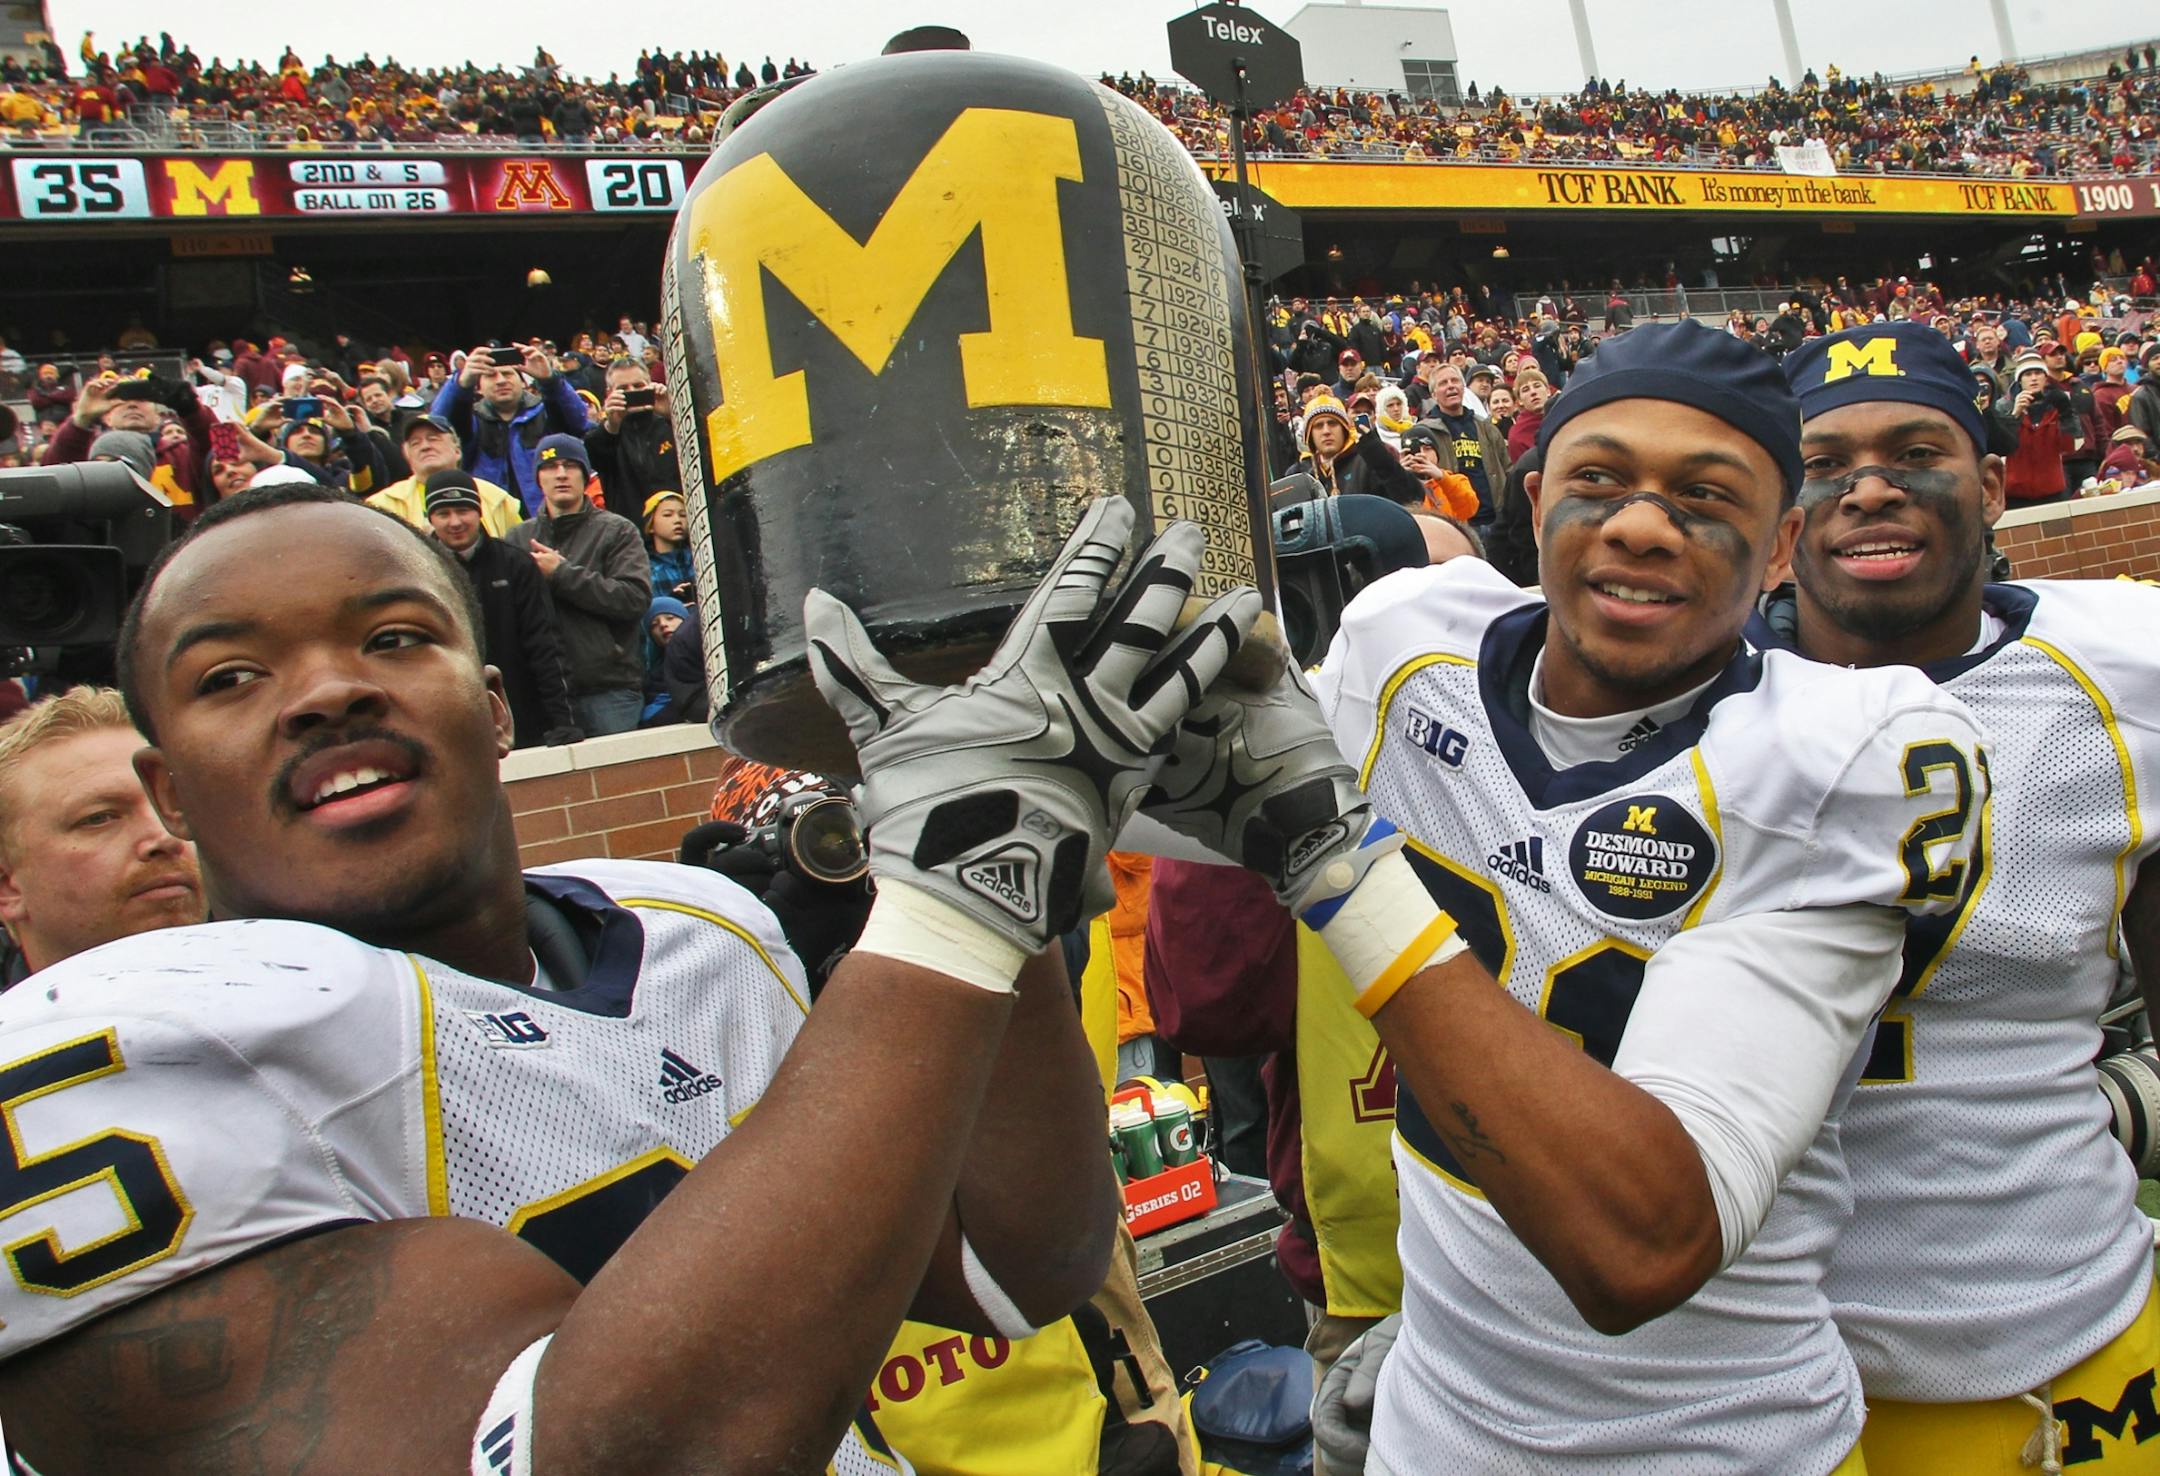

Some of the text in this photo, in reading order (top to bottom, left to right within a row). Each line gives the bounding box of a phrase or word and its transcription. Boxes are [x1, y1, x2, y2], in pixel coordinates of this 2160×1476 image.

[1202, 15, 1263, 45] Telex
[1116, 131, 1141, 151] 38
[33, 165, 124, 213] 35
[164, 160, 260, 215] M
[304, 165, 420, 183] 2ND & 5
[604, 164, 672, 206] 20
[1121, 151, 1145, 171] 16
[1153, 164, 1194, 194] 1922
[1538, 173, 1683, 205] TCF BANK
[303, 194, 360, 210] BALL
[405, 193, 436, 210] 26
[1124, 171, 1147, 195] 10
[1158, 181, 1195, 213] 1923
[1699, 177, 1876, 208] It's money in the bank.
[1959, 184, 1997, 209] TCF
[2080, 185, 2133, 212] 1900
[1126, 192, 1217, 244] 13 1924 0
[1126, 215, 1150, 236] 35
[1131, 239, 1153, 257] 20
[1164, 255, 1202, 283] 1926
[1138, 256, 1150, 270] 7
[689, 107, 1112, 486] M
[1138, 274, 1226, 322] 7 1927 13
[1140, 301, 1227, 346] 7 1929 6
[1142, 326, 1230, 369] 7 1930 0
[1824, 338, 1898, 383] M
[1146, 351, 1232, 393] 6 1931 0
[1150, 374, 1235, 416] 3 1932 0
[1152, 397, 1237, 439] 0 1933 0
[1154, 422, 1243, 465] 0 1934 34
[1157, 447, 1246, 487] 0 1935 40
[1189, 476, 1228, 501] 1936
[1231, 487, 1247, 509] 26
[1162, 495, 1249, 533] 6 1937 39
[1201, 527, 1248, 553] 938 7
[1239, 558, 1255, 580] 20
[1623, 805, 1656, 833] M
[1585, 831, 1695, 861] DESMOND
[1587, 851, 1688, 879] HOWARD
[971, 872, 1031, 913] adidas
[1487, 854, 1551, 894] adidas
[1584, 869, 1688, 892] MICHIGAN LEGEND
[663, 1072, 723, 1104] adidas
[1169, 1122, 1194, 1152] G
[1135, 1191, 1178, 1217] SERIES
[1181, 1180, 1202, 1201] 02
[2053, 1368, 2160, 1466] M
